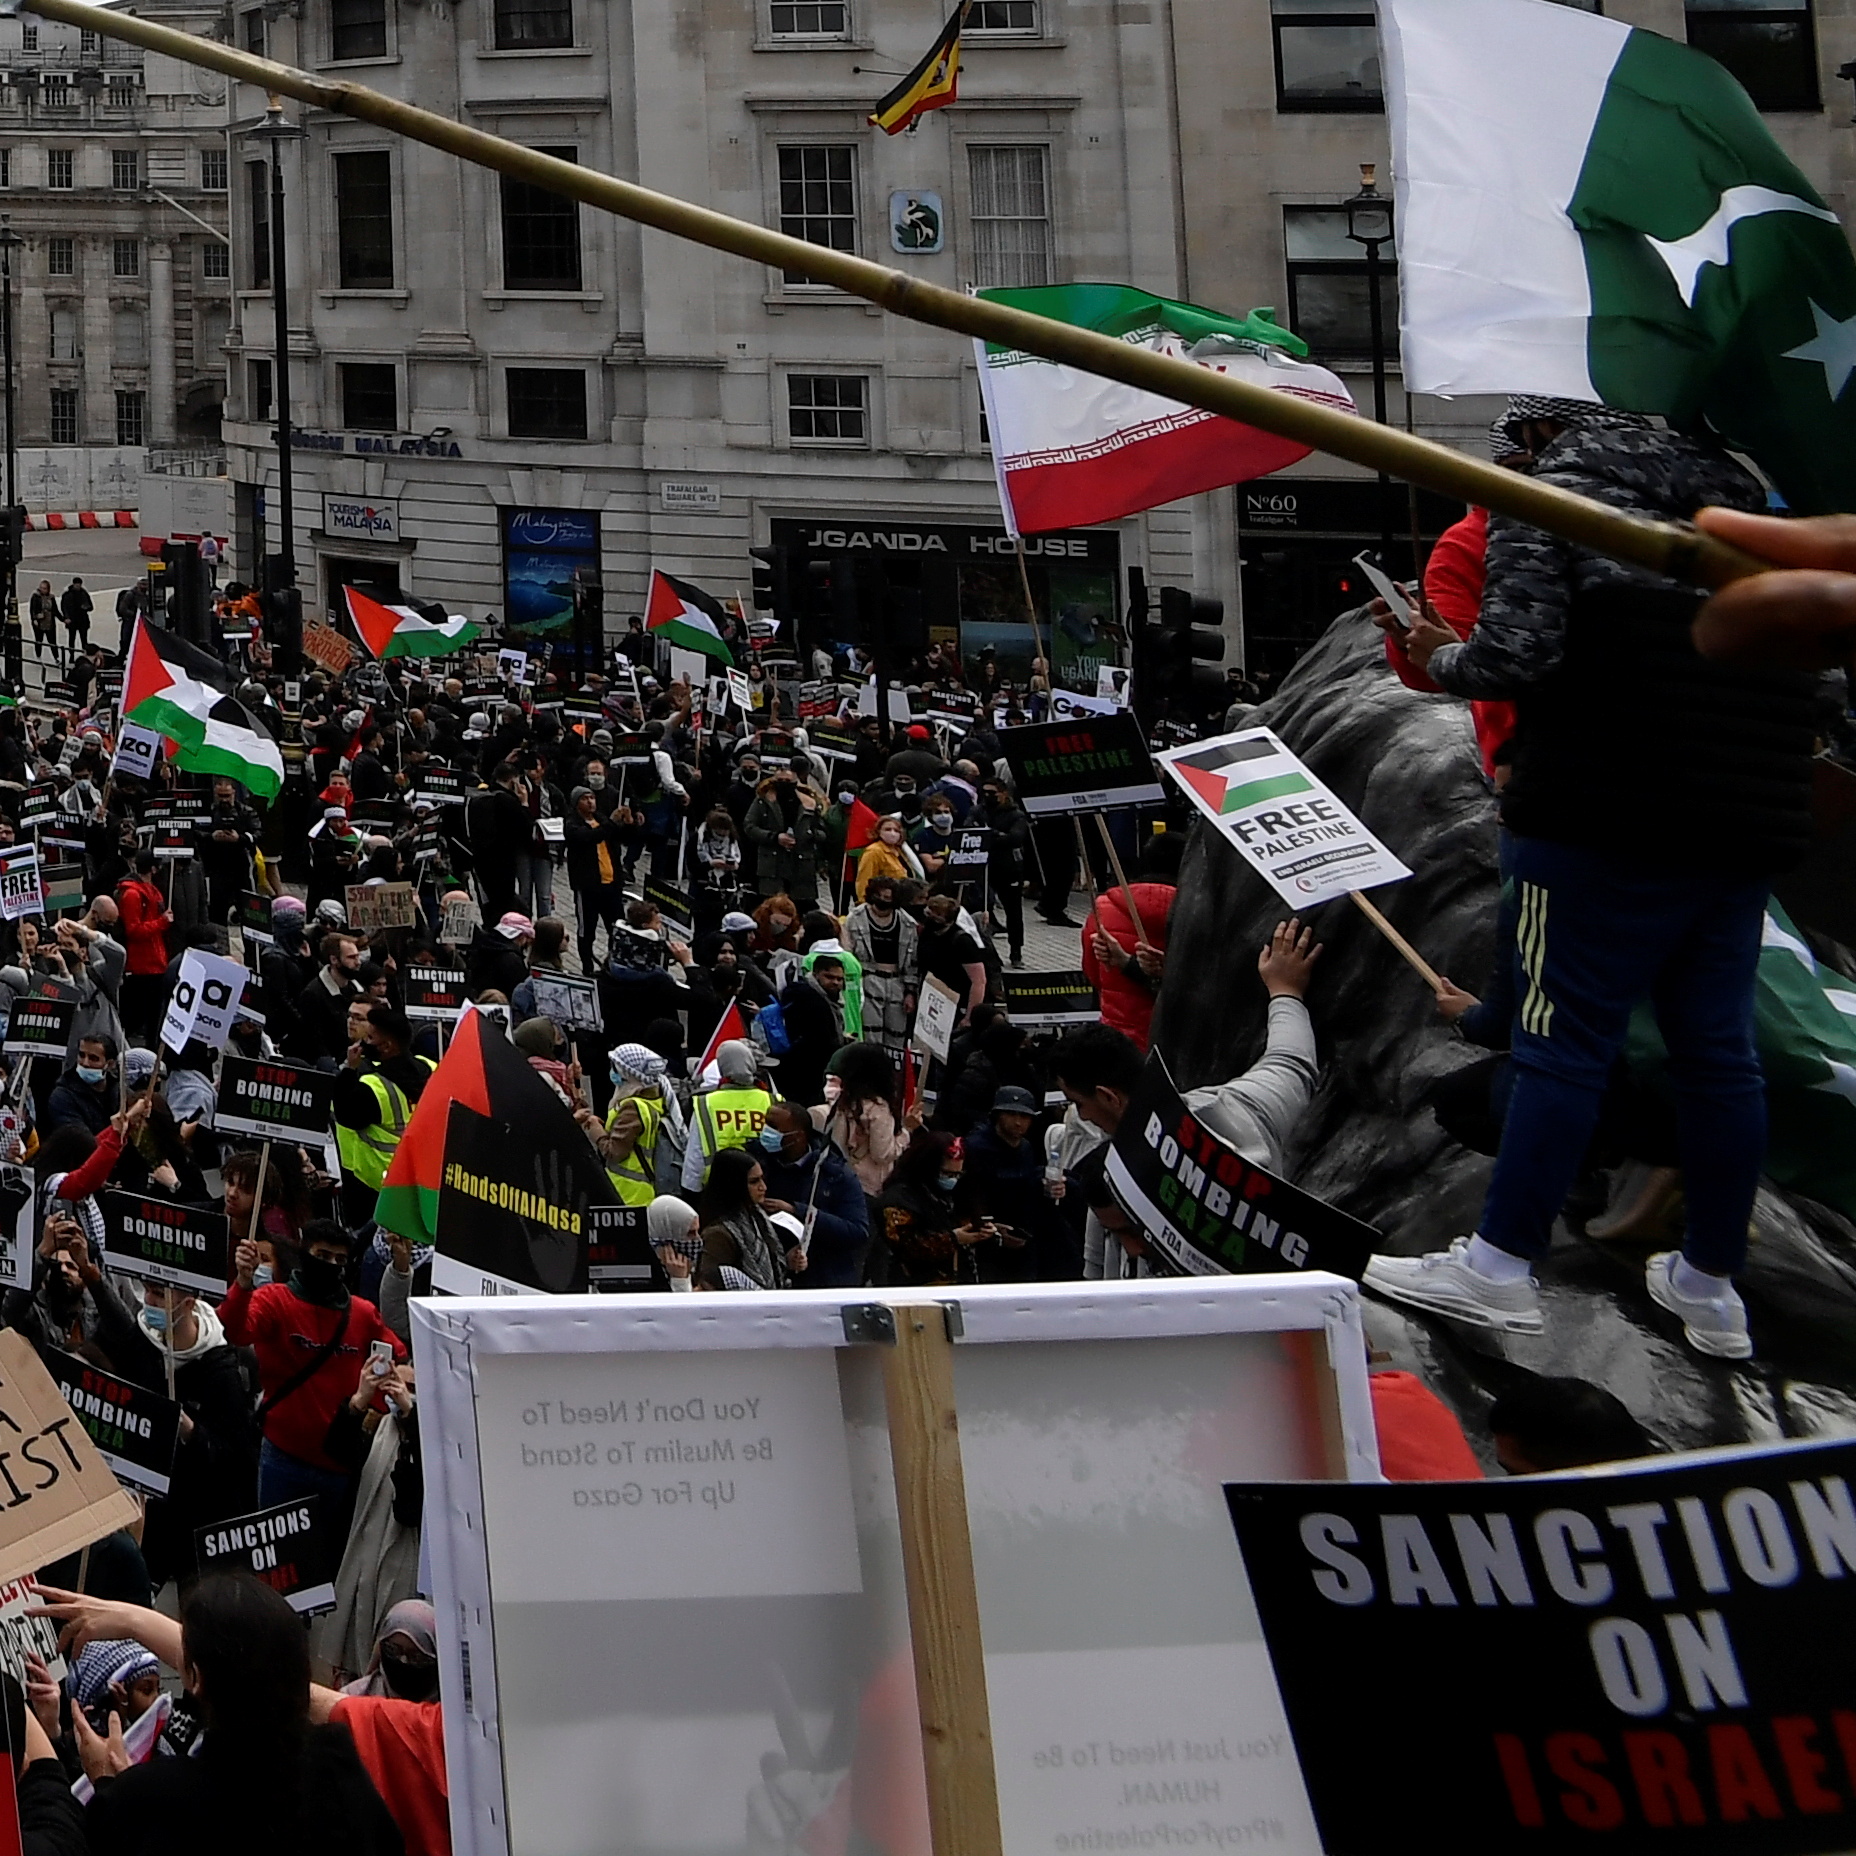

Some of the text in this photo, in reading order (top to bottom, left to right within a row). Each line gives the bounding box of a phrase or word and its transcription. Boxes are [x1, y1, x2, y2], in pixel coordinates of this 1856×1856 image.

[355, 437, 463, 458] MALAYSIA
[666, 485, 708, 493] TRAFALGAR
[328, 504, 365, 517] TOURISM
[334, 514, 391, 535] MALAYSIA
[970, 535, 1088, 557] HOUSE
[1230, 799, 1341, 844] FREE
[1251, 821, 1356, 861] PALESTINE
[715, 1110, 766, 1132] PFB
[1176, 1113, 1273, 1201] STOP
[445, 1162, 582, 1235] #HandsOffAlAqsa
[1144, 1110, 1309, 1268] BOMBING
[1159, 1173, 1246, 1265] GAZA
[1298, 1474, 1856, 1607] SANCTION
[1589, 1608, 1749, 1718] ON
